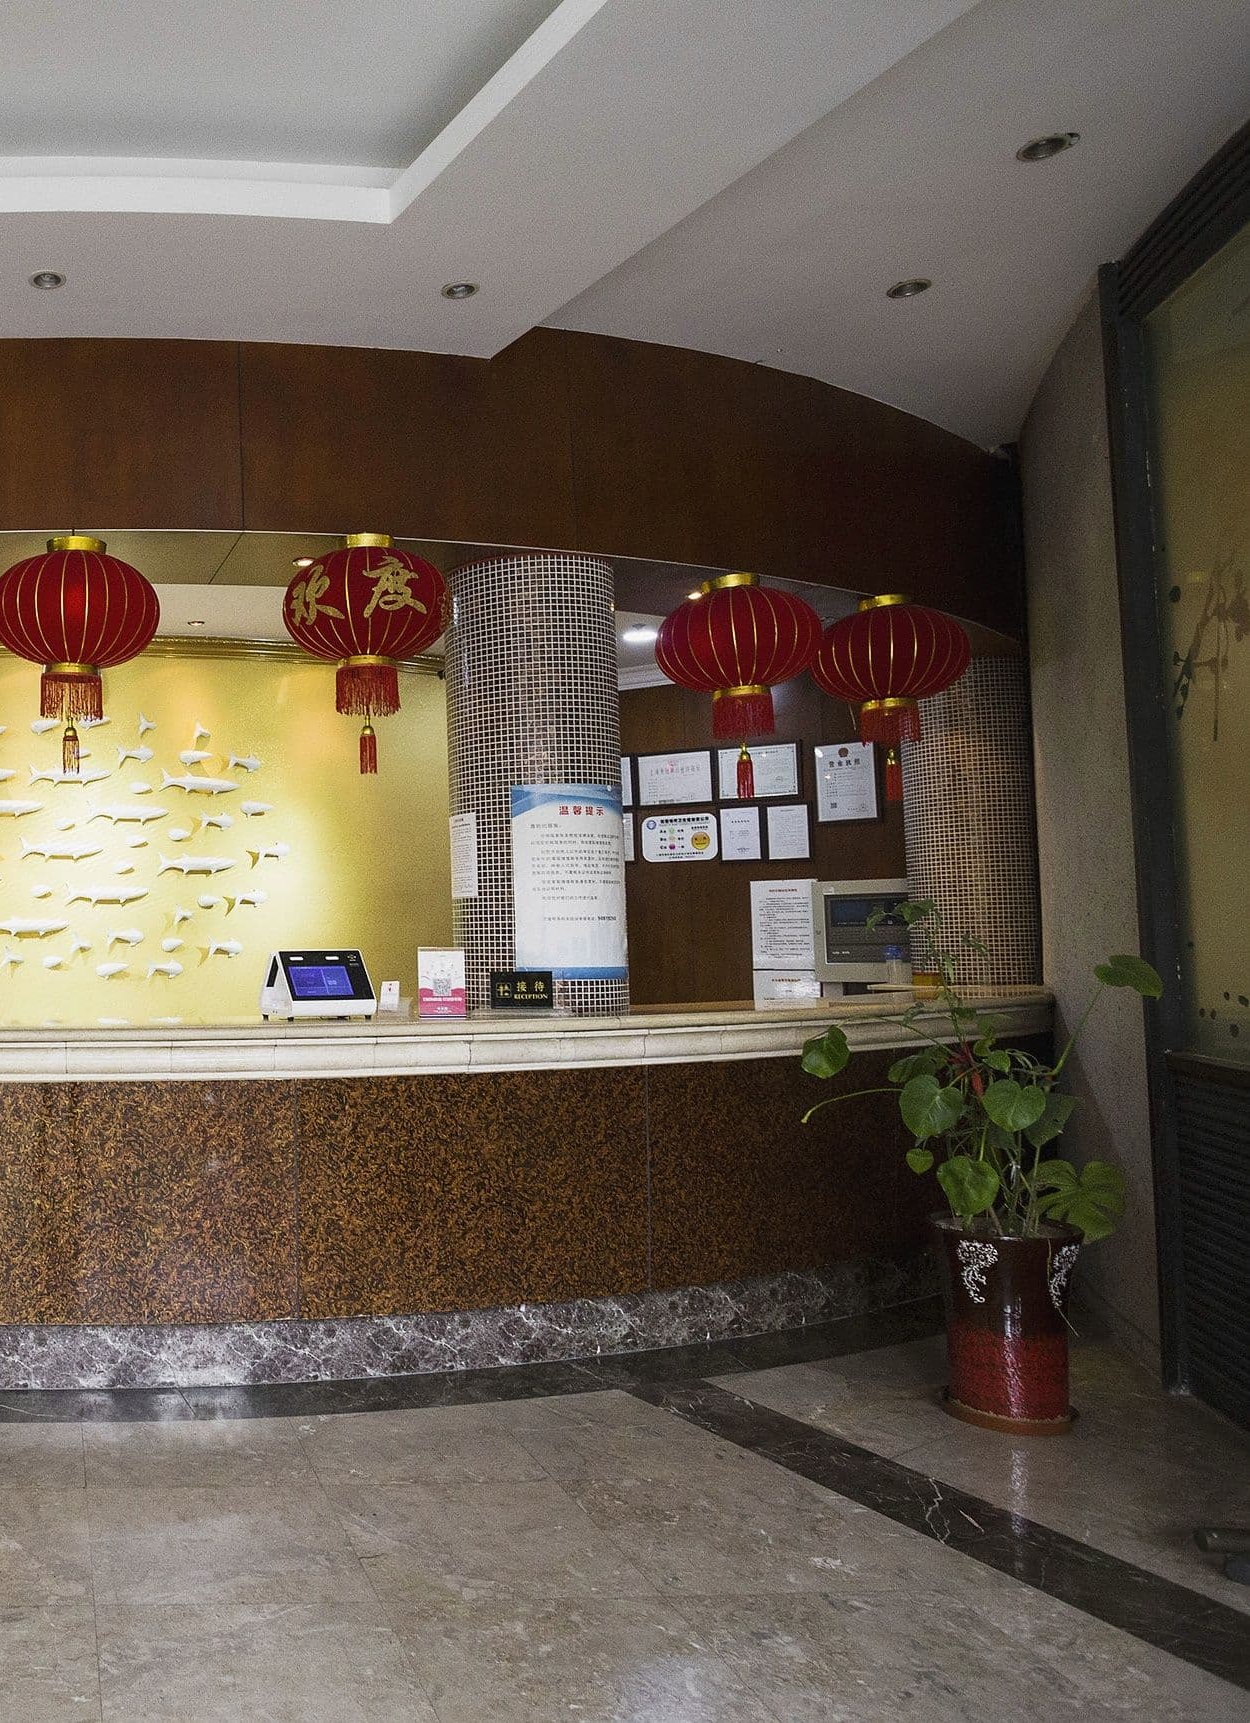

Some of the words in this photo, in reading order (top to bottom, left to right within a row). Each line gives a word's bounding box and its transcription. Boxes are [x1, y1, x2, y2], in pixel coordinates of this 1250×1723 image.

[558, 805, 605, 816] 温馨提示
[516, 980, 545, 992] 接待
